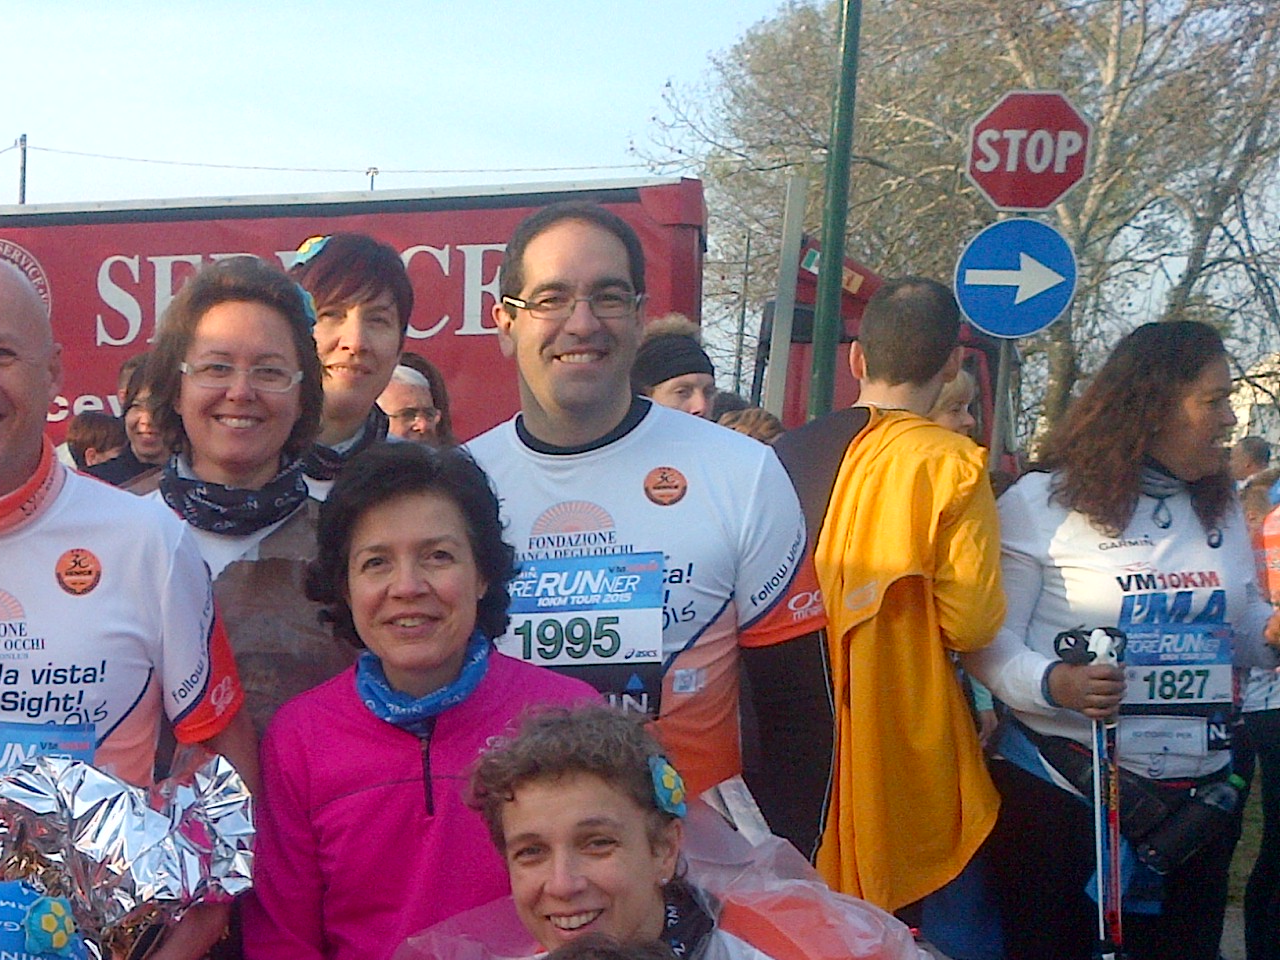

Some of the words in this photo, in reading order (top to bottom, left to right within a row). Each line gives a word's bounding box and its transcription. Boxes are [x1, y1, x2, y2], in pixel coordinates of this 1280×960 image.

[975, 129, 1084, 174] STOP
[528, 531, 617, 549] FONDAZIONE
[1098, 539, 1155, 551] GARMIN
[750, 564, 788, 607] follow
[1116, 570, 1220, 592] VM10KM
[537, 596, 567, 608] 10KM
[570, 595, 600, 606] TOUR
[603, 592, 632, 603] 2015
[4, 637, 46, 651] OCCHI
[514, 616, 621, 660] 1995
[31, 659, 107, 684] vista!
[1143, 669, 1210, 700] 1827
[0, 690, 84, 718] Sight!
